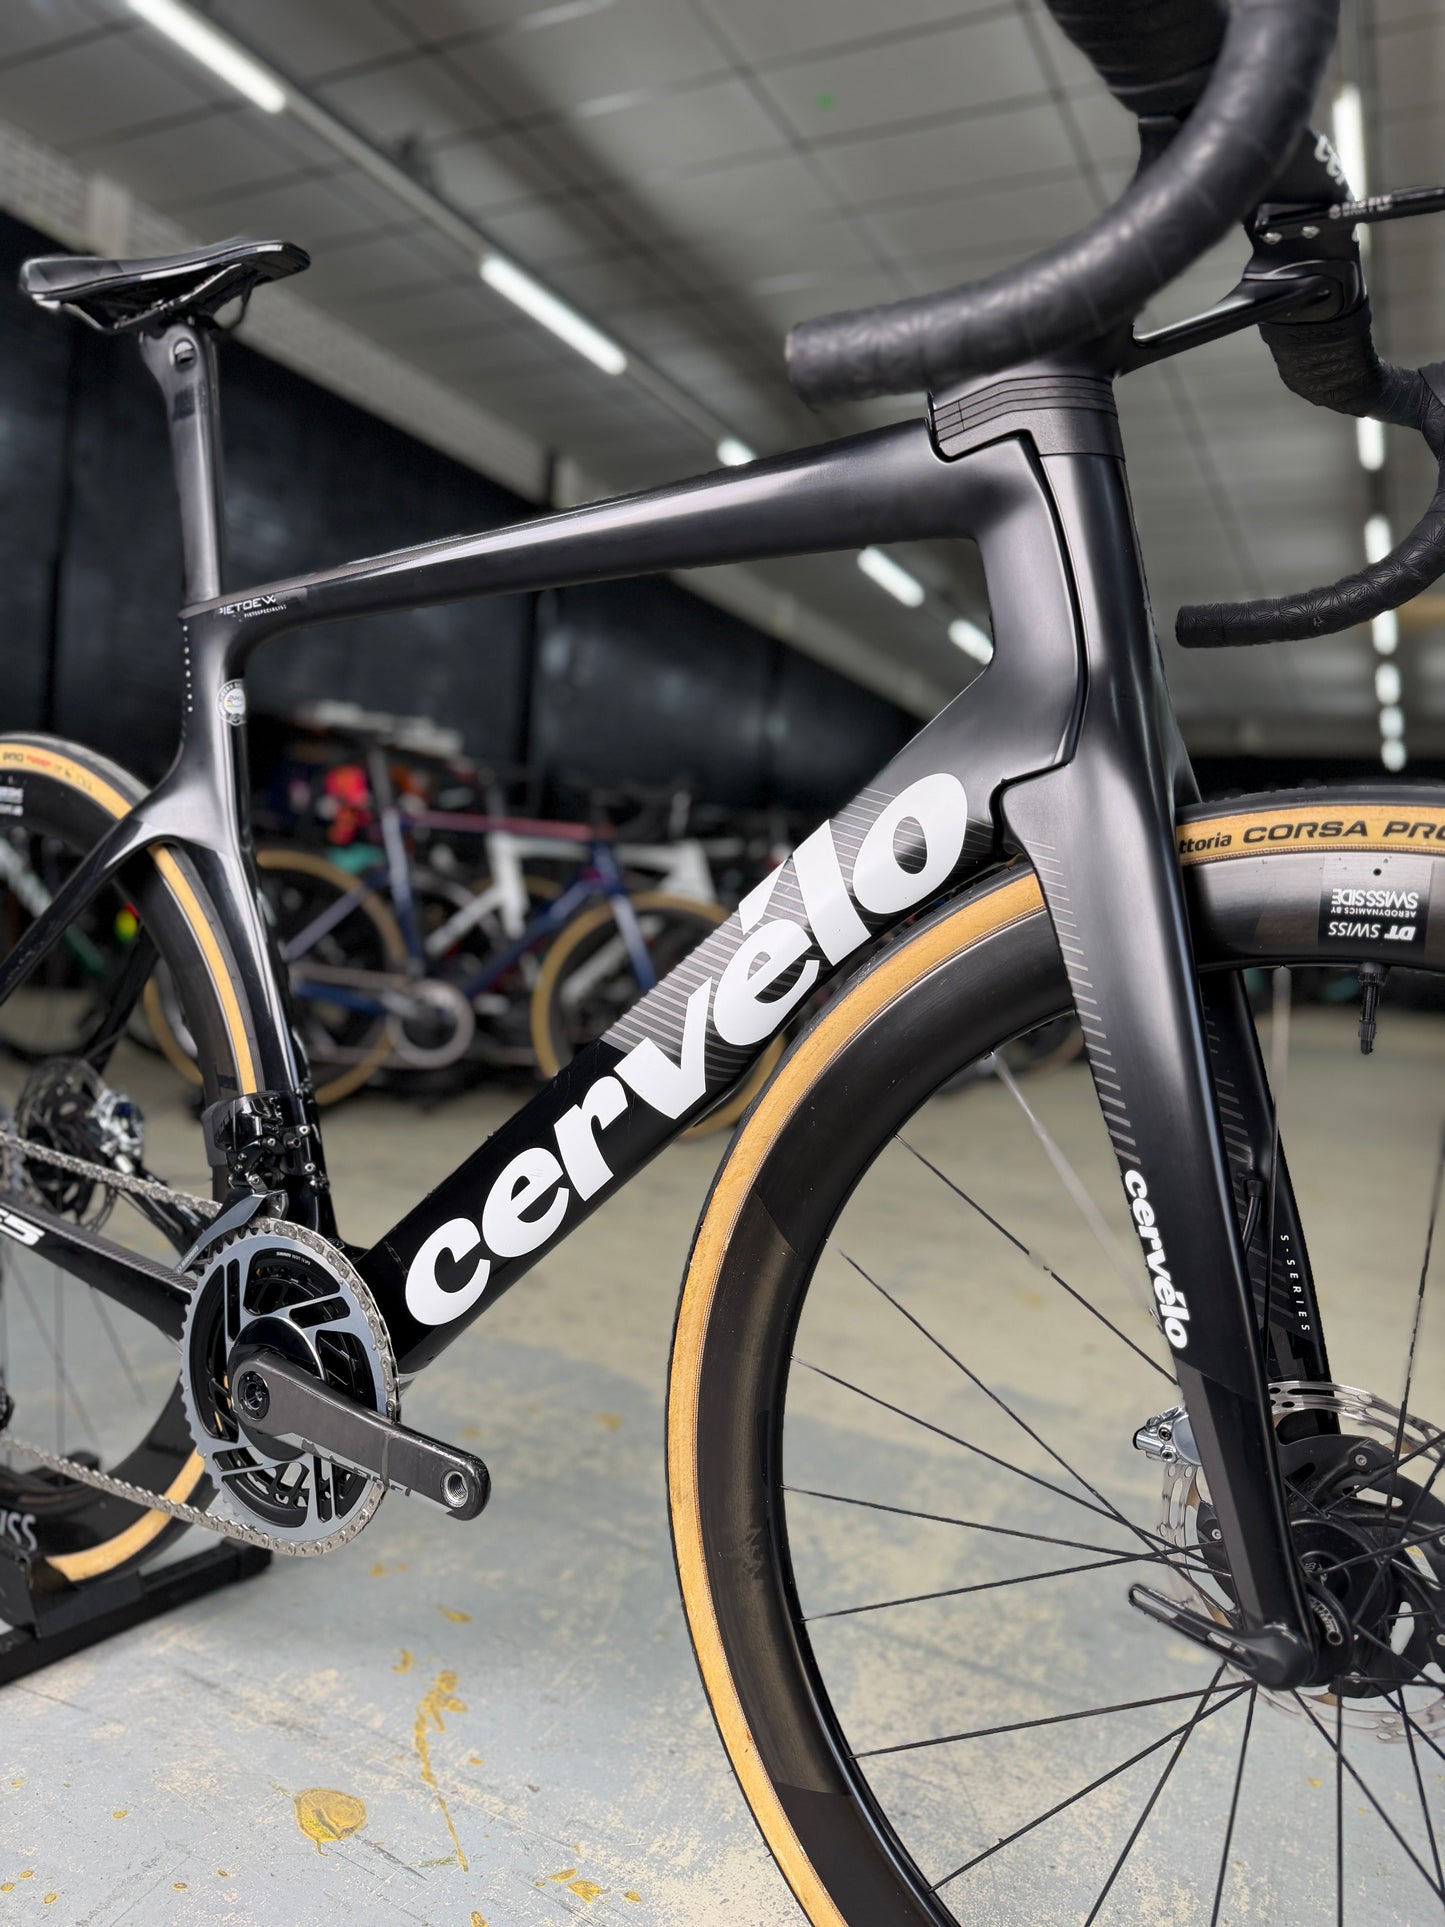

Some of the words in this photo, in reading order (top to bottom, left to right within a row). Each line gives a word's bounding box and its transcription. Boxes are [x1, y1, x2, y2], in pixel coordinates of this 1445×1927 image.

[1242, 820, 1368, 844] CORSA
[1331, 888, 1419, 910] SWISSSIDE
[1330, 906, 1342, 914] BY
[1344, 906, 1416, 918] AERODYNAMICS
[1328, 921, 1381, 939] SWISS
[1383, 925, 1416, 941] DT
[405, 772, 968, 1326] cervélo
[1125, 1169, 1190, 1349] cervélo
